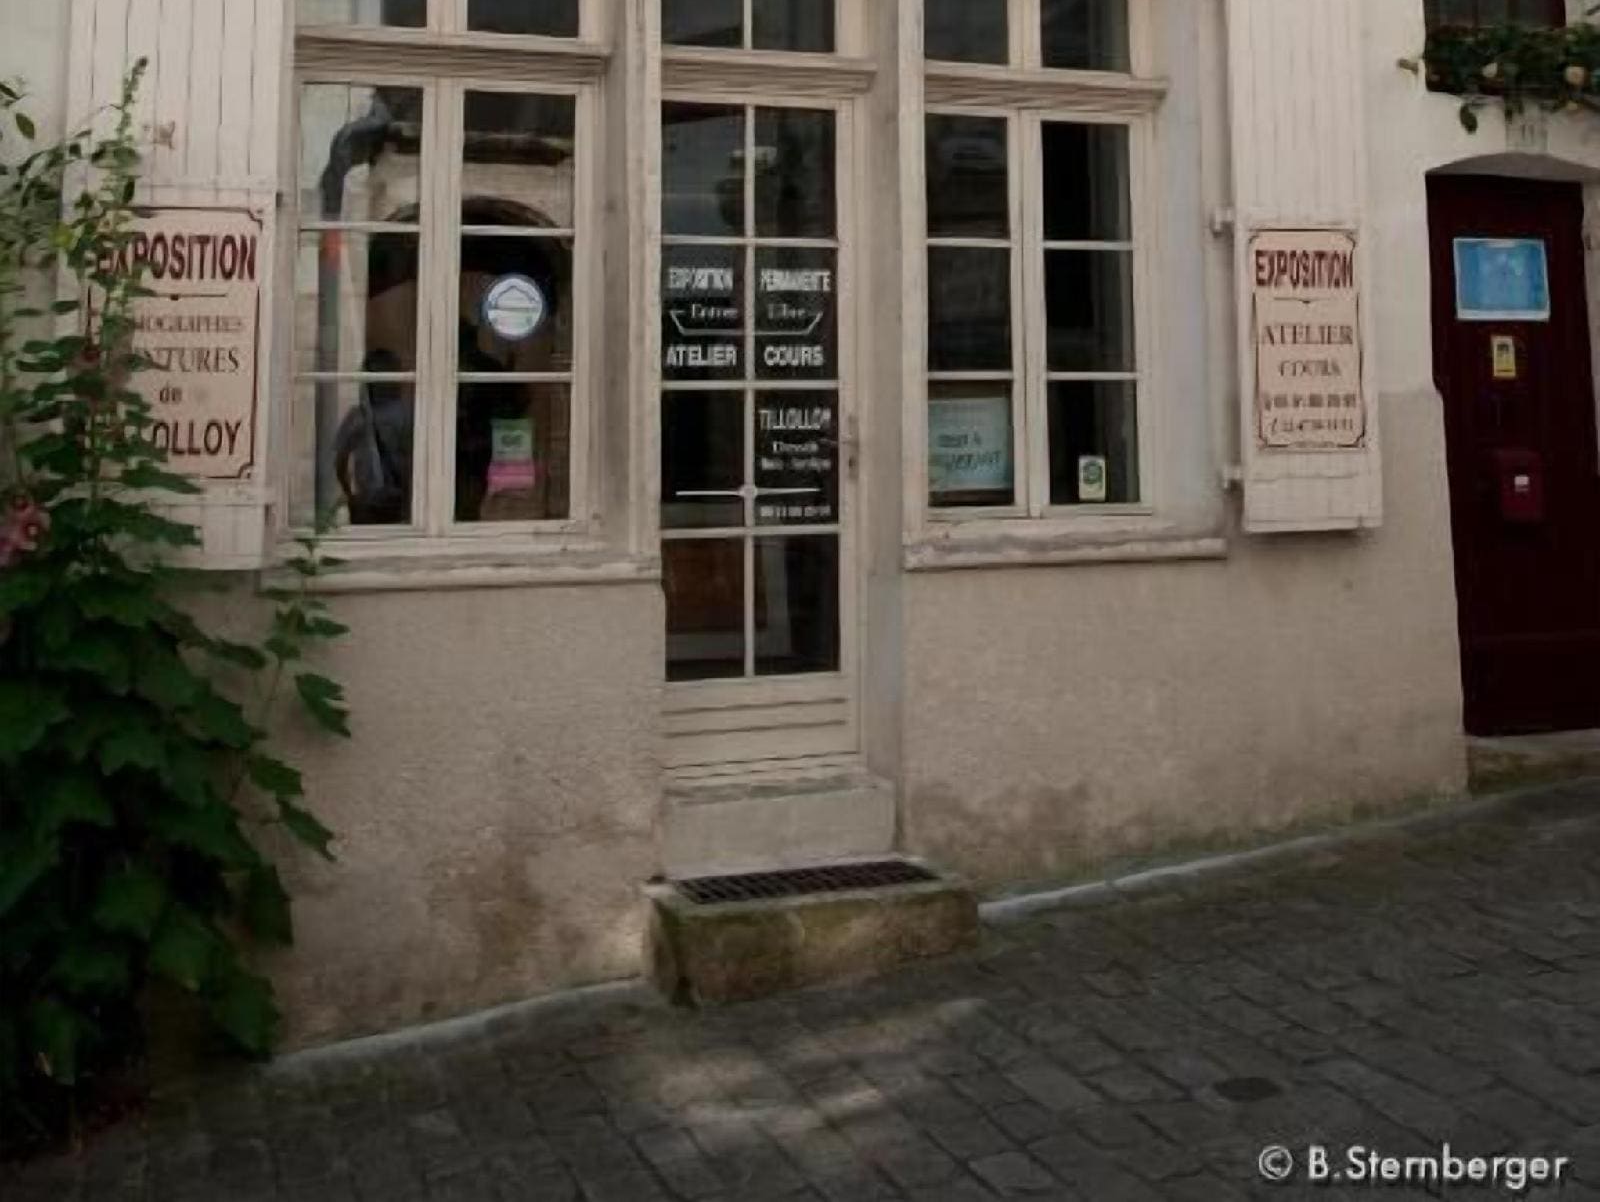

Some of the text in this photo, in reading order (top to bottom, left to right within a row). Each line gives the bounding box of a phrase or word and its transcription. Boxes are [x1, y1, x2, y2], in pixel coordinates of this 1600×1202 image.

[1255, 249, 1354, 289] EXPOSITION
[665, 344, 825, 367] ATELIER COURS
